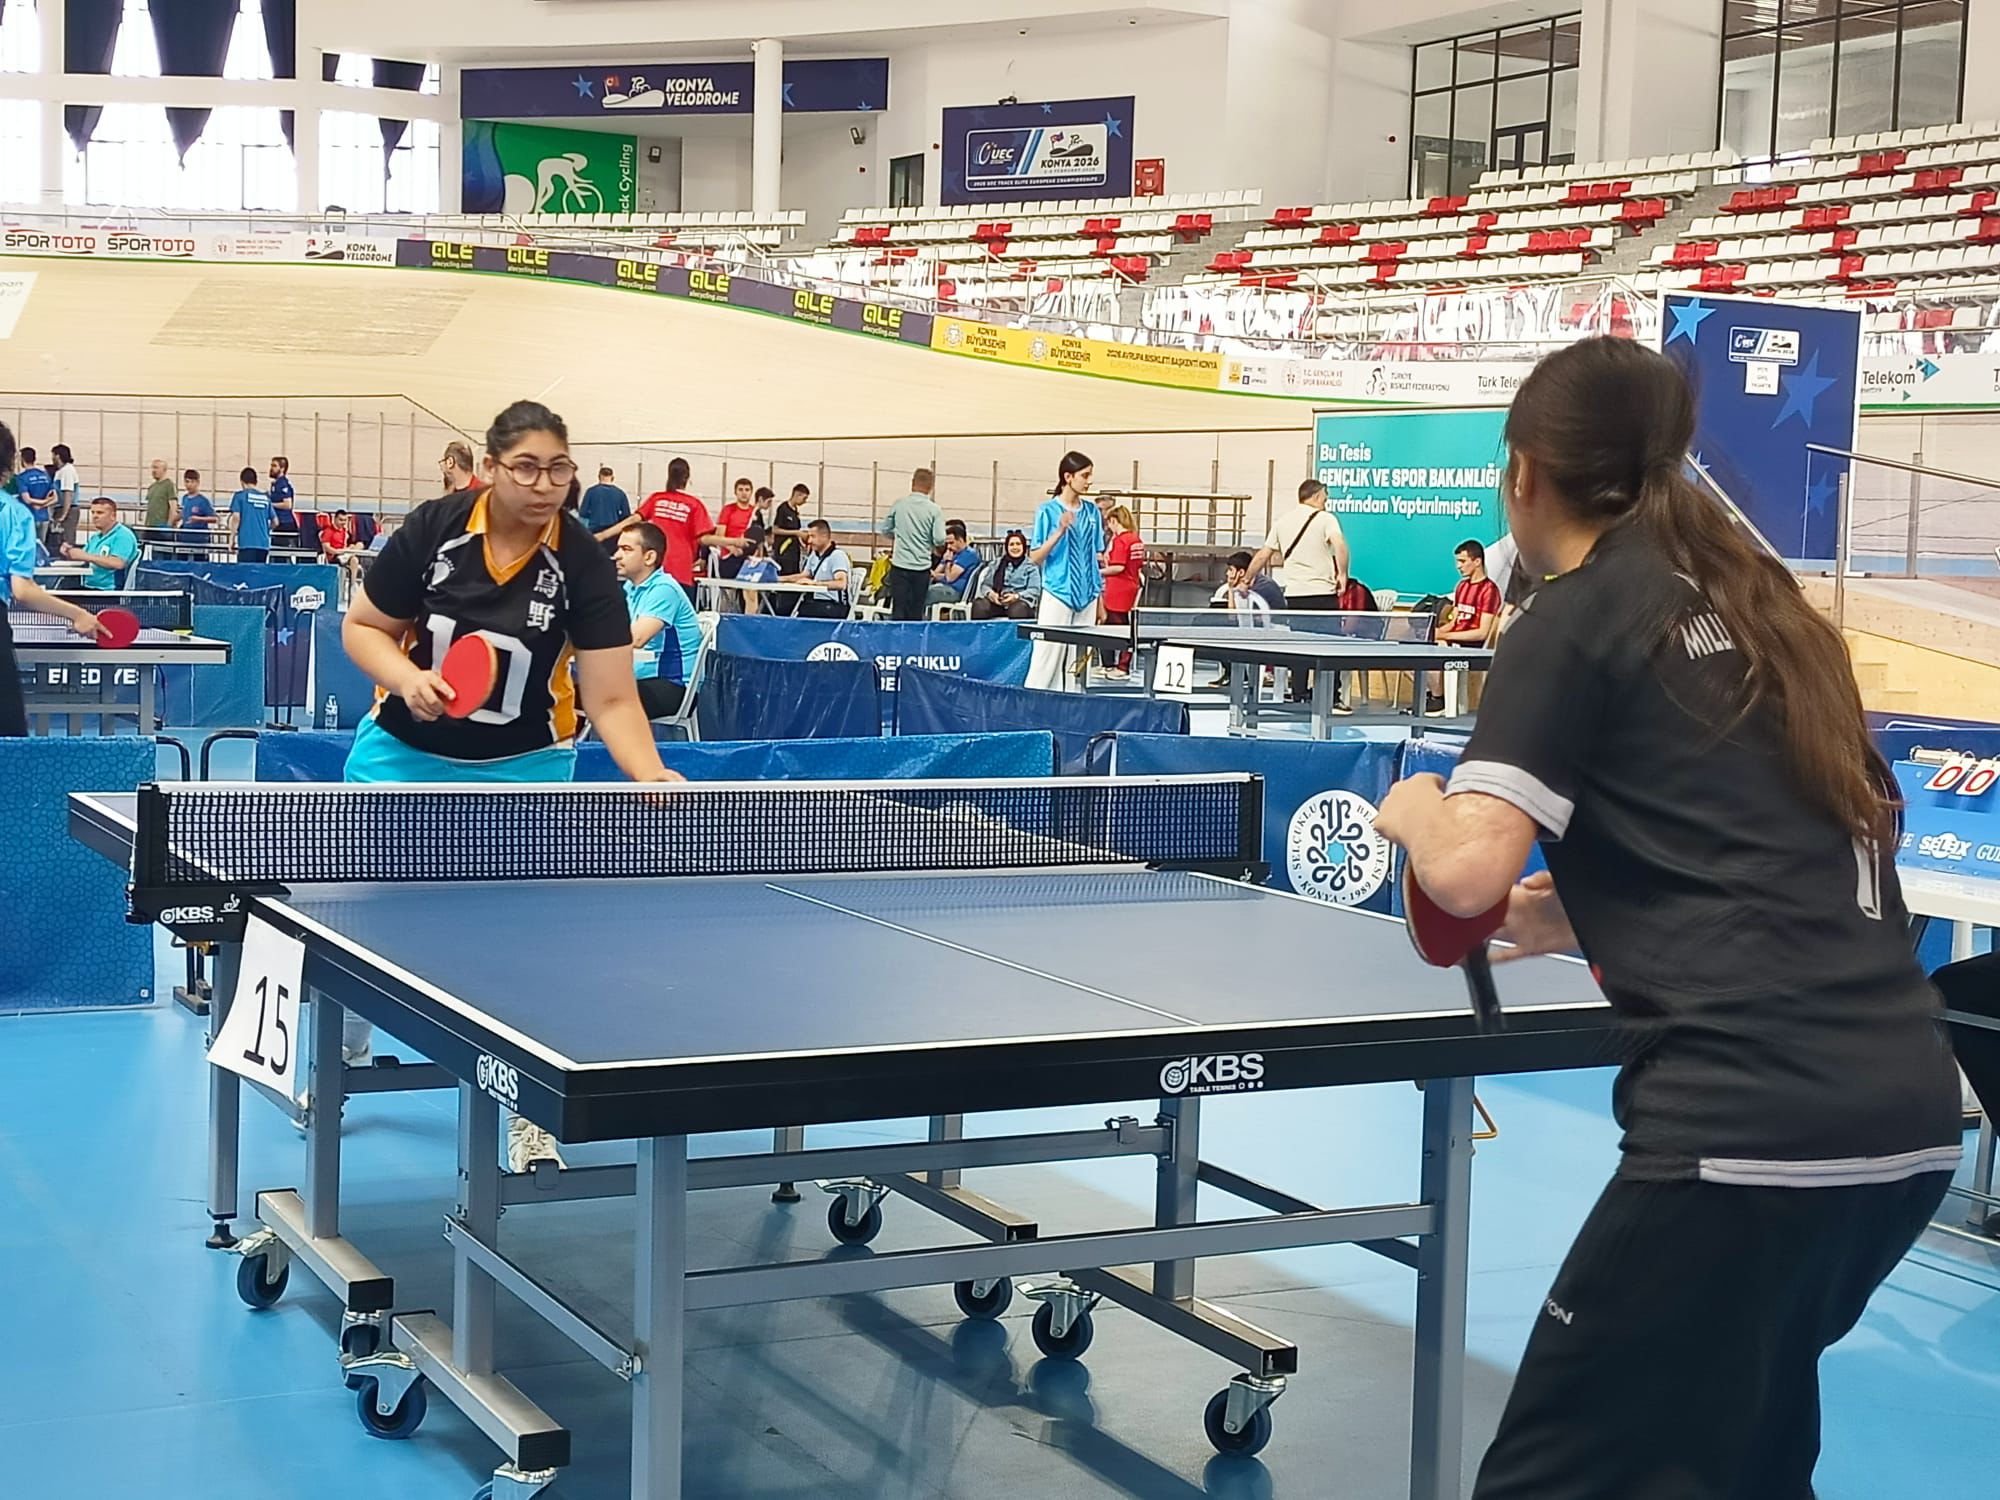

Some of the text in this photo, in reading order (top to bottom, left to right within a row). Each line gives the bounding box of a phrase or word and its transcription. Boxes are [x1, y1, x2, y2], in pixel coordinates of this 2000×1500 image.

[665, 78, 714, 92] KONYA
[665, 91, 740, 106] VELODROME
[991, 148, 1014, 160] UEC
[1041, 157, 1100, 168] KONYA 2026
[619, 144, 633, 192] Cycling
[346, 243, 377, 252] KONYA
[346, 252, 393, 263] VELODROME
[1478, 375, 1497, 388] Türk
[1862, 370, 1916, 385] Telekom
[1320, 442, 1372, 461] Bu Tesis
[1319, 463, 1501, 493] GENÇLİK VE SPOR BAKANLIĞI
[1325, 494, 1482, 520] arafından Yaptırılmıştır.
[426, 613, 533, 725] 10
[1165, 661, 1186, 688] 12
[1300, 881, 1339, 903] KONYA
[1349, 882, 1372, 901] 1989
[176, 905, 214, 920] KBS
[243, 975, 289, 1076] 15
[488, 1055, 519, 1100] KBS
[1190, 1053, 1264, 1083] KBS
[1545, 1298, 1574, 1326] ON
